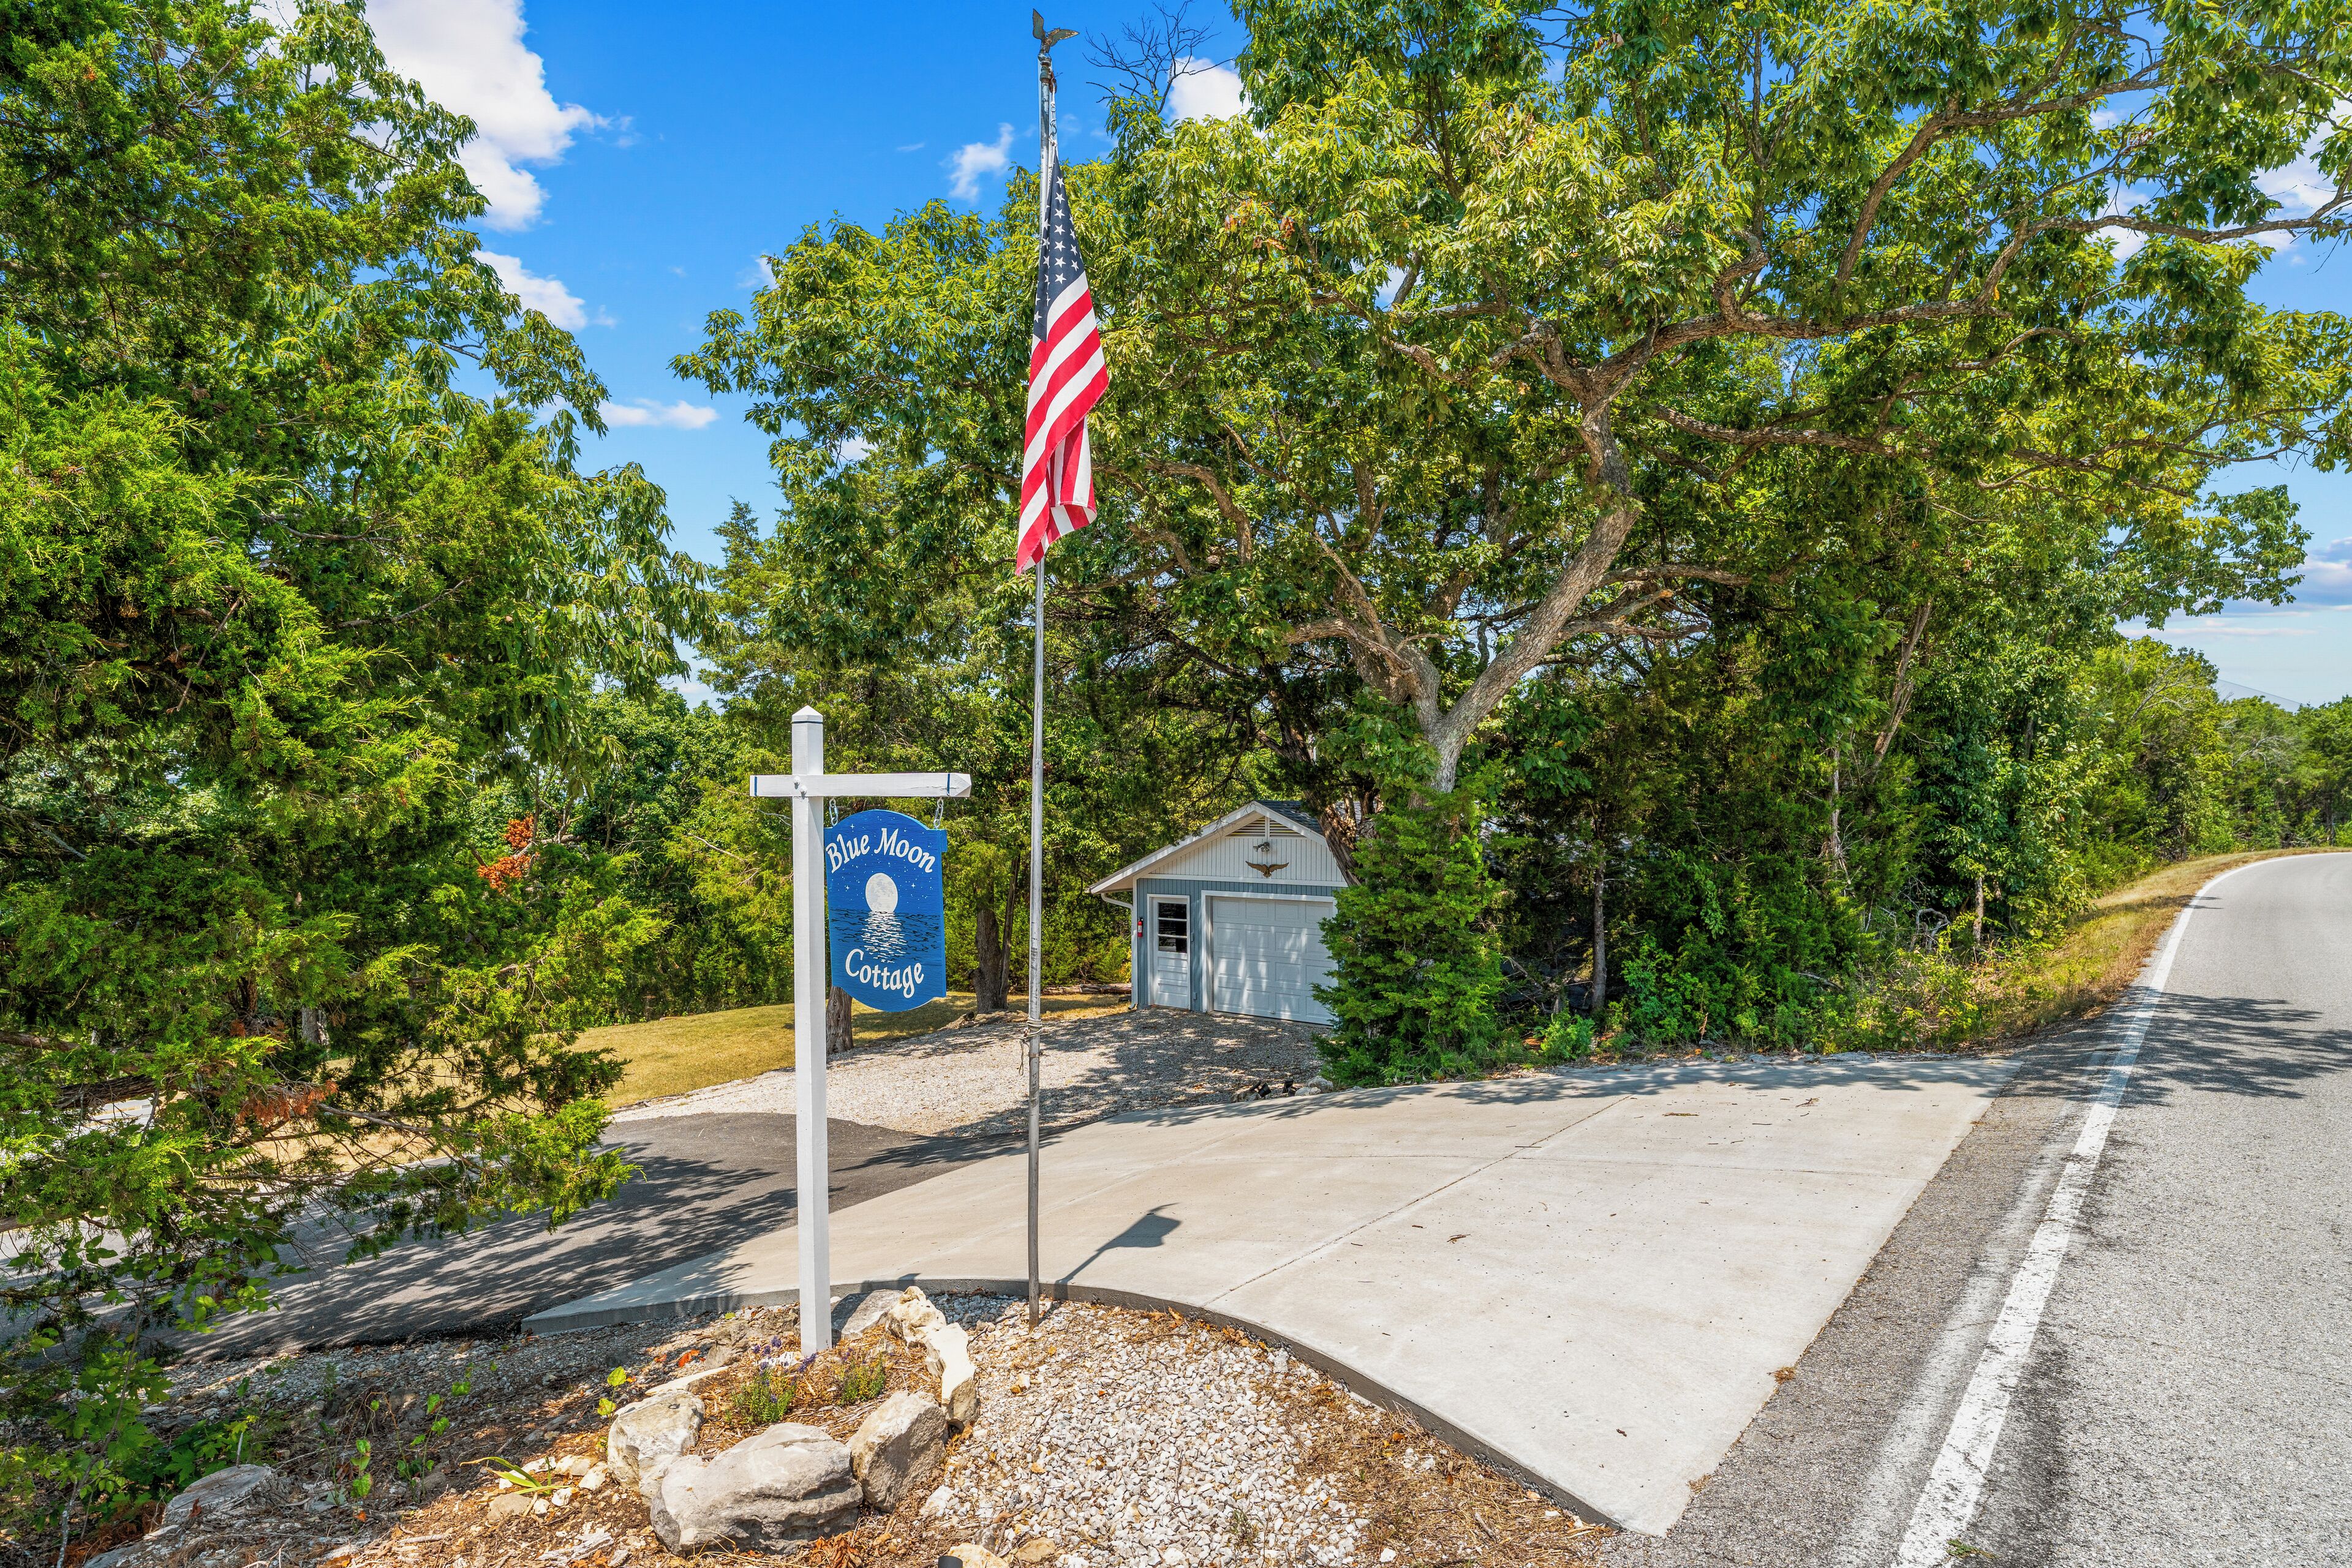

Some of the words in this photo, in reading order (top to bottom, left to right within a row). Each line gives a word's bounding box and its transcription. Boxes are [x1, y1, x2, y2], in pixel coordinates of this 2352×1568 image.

[826, 834, 870, 873] Blue
[874, 828, 935, 873] Moon
[845, 949, 924, 998] Cottage
